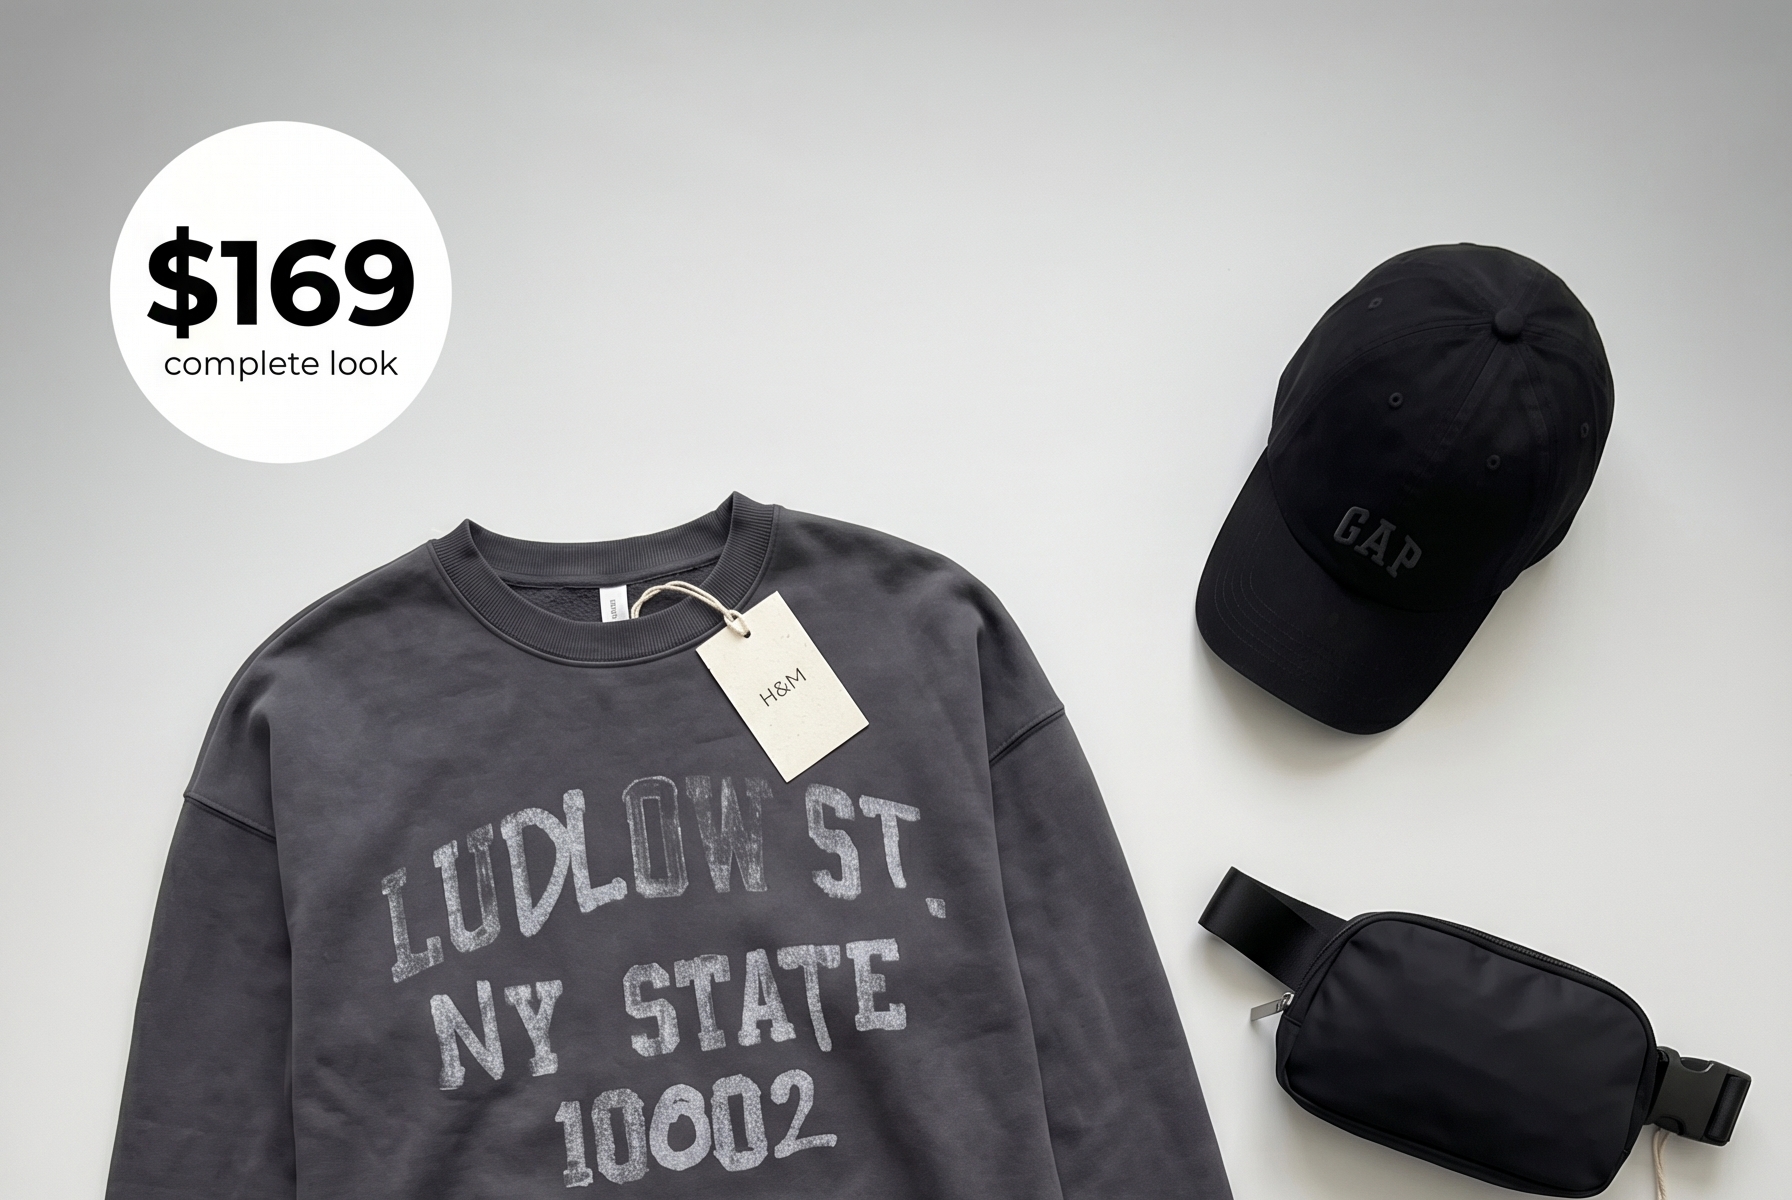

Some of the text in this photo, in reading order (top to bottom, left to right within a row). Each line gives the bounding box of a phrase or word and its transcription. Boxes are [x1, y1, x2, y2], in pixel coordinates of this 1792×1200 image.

[1333, 506, 1422, 578] GAP
[759, 667, 806, 706] H&M
[381, 776, 773, 982] LUDLOW
[430, 938, 907, 1090] NY STATE
